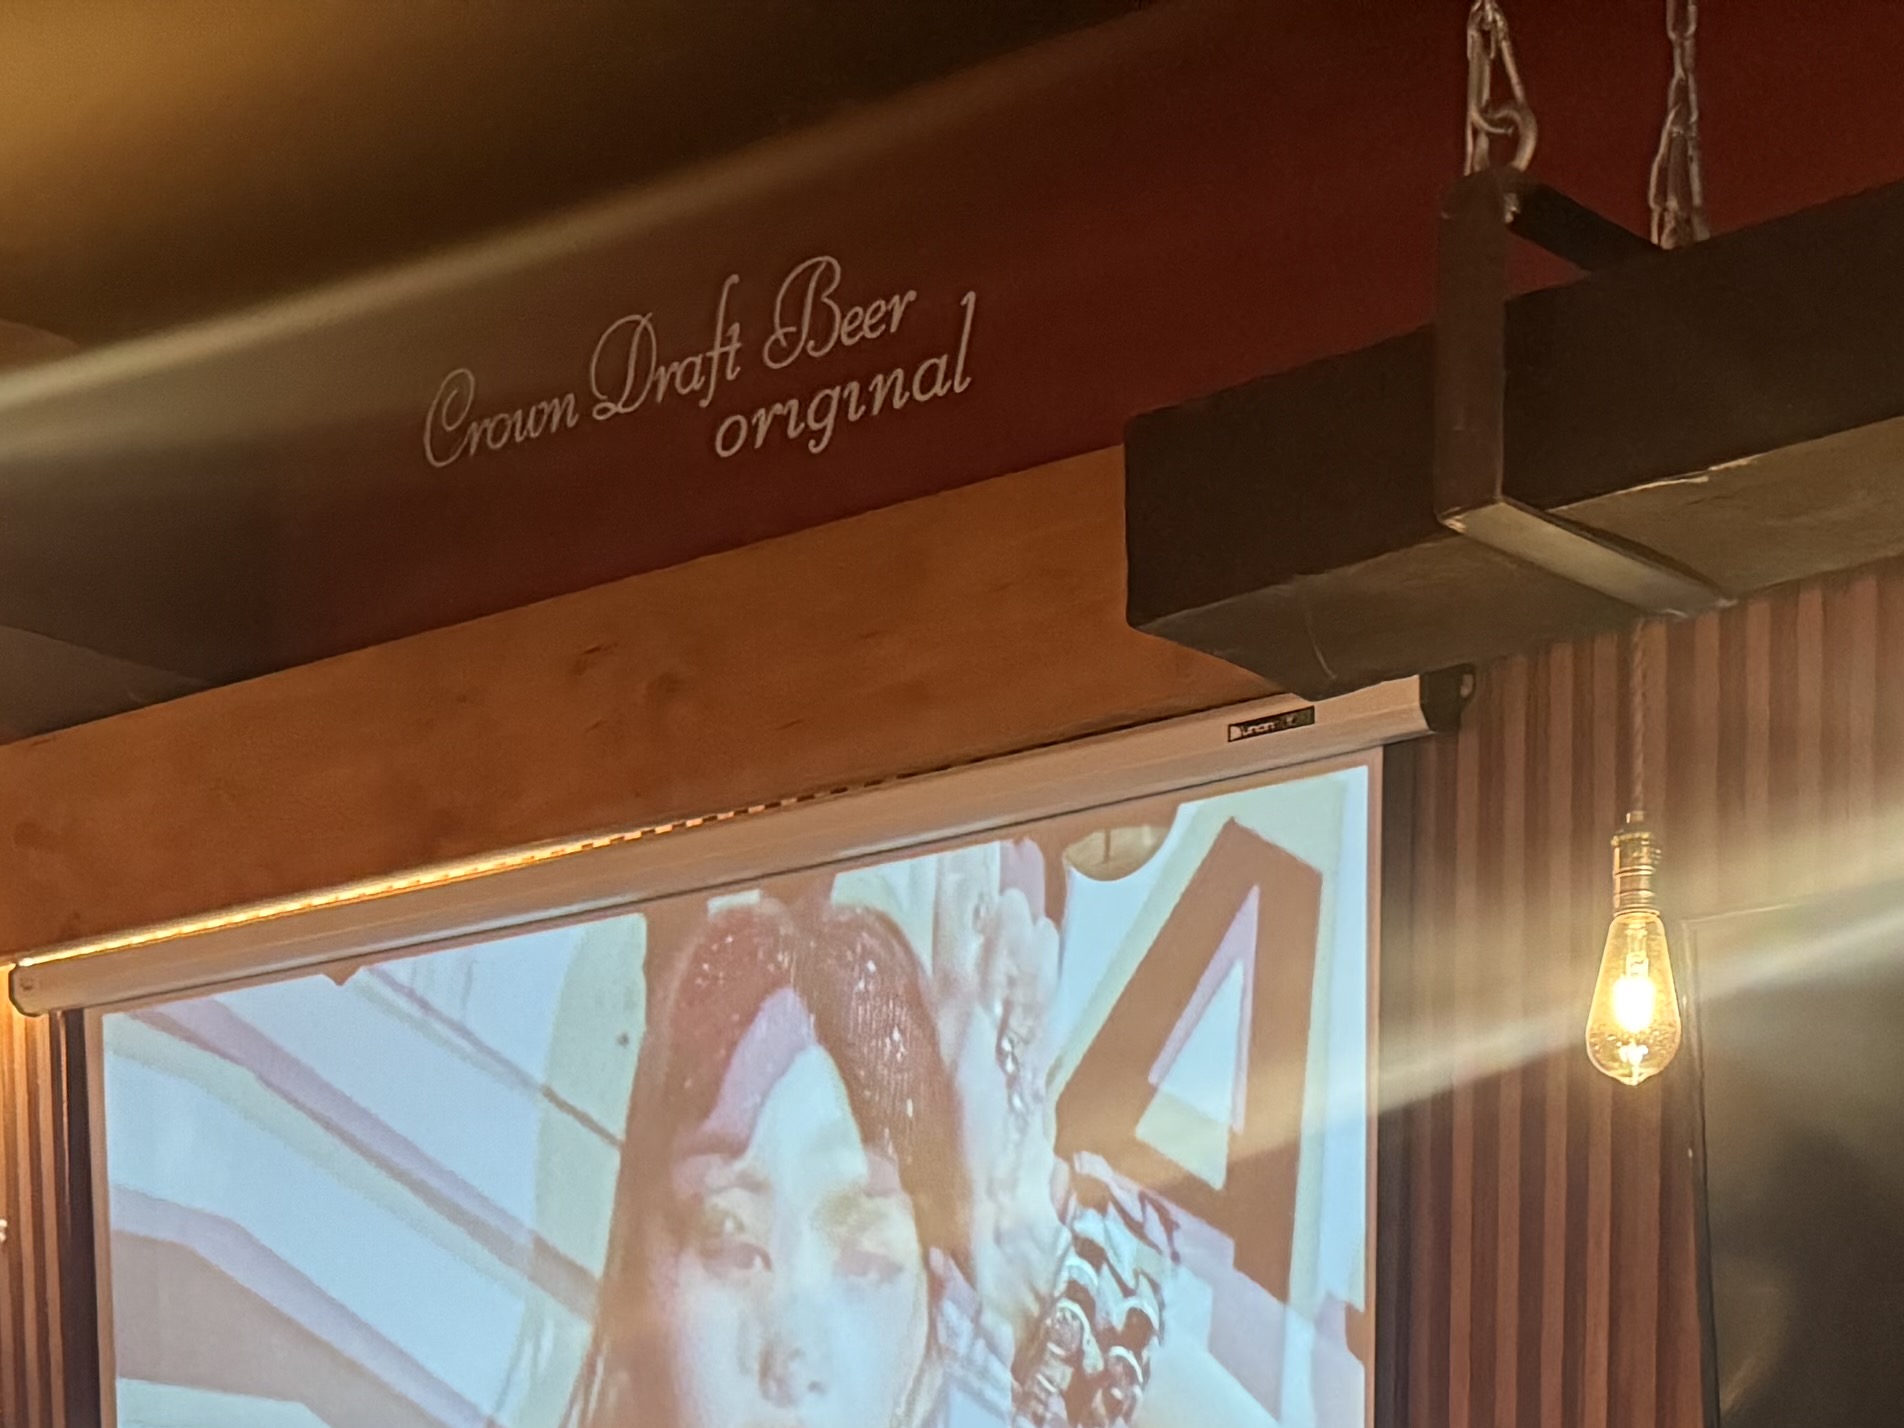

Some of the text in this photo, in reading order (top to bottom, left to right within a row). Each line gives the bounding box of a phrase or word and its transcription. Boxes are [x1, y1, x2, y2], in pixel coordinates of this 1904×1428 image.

[422, 254, 918, 468] Crown Draft Beer
[714, 290, 978, 459] original
